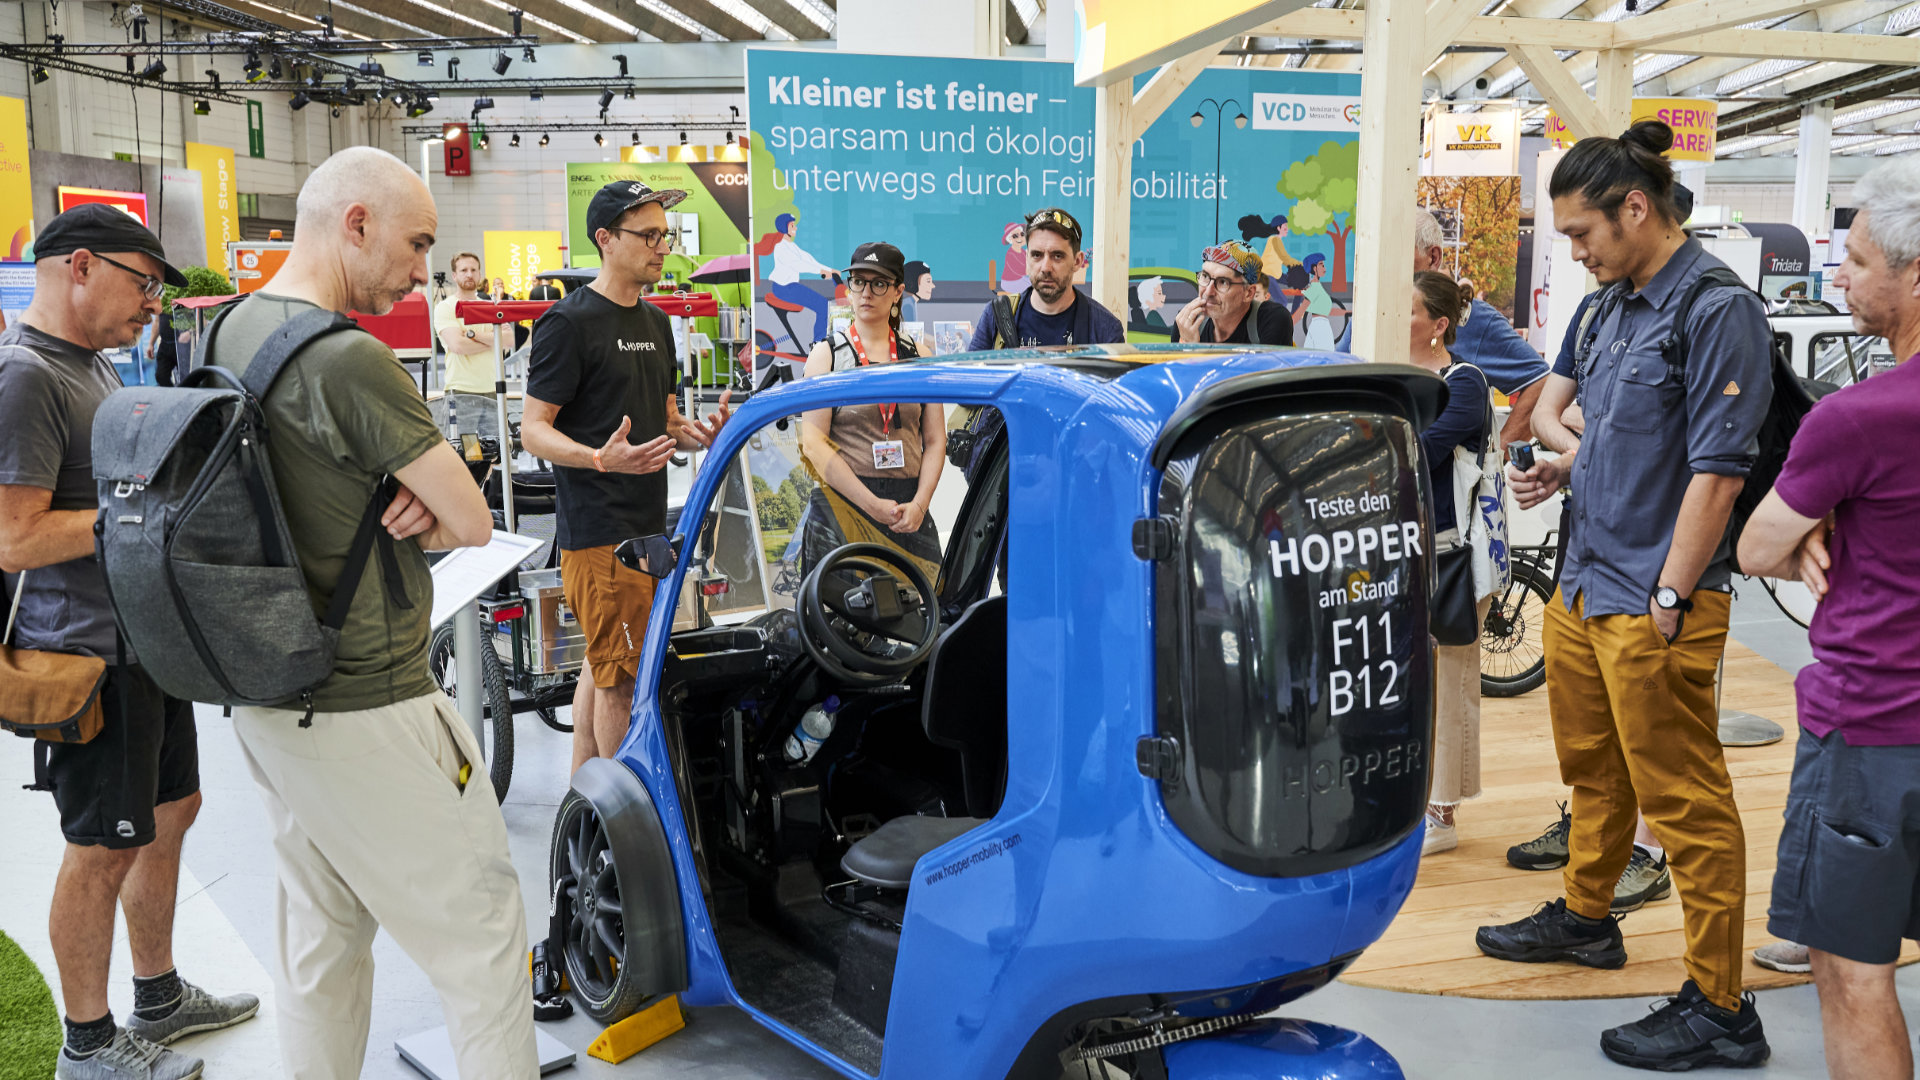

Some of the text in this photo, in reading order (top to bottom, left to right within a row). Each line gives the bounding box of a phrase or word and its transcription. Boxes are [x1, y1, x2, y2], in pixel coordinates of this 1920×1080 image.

[769, 76, 886, 108] Kleiner
[896, 80, 936, 110] ist
[944, 82, 1038, 113] feiner
[1262, 102, 1306, 121] VCD
[771, 125, 1145, 163] sparsam und ökologi
[1457, 124, 1492, 142] VK
[1672, 133, 1712, 152] AREA
[450, 147, 463, 168] P
[218, 158, 229, 210] Stage
[773, 165, 1228, 200] unterwegs durch Feinobilität
[246, 257, 255, 266] 25
[508, 243, 521, 296] Yellow
[525, 244, 540, 290] Stage
[1772, 258, 1803, 272] Tridata
[627, 341, 656, 351] HOPPER
[1305, 491, 1391, 520] Teste den
[1270, 521, 1423, 578] HOPPER
[1319, 574, 1399, 608] am Stand
[1332, 611, 1392, 666] F11
[1329, 660, 1400, 717] B12
[1283, 738, 1422, 801] HOPPER
[924, 833, 1023, 887] www.hopper-mobility.com
